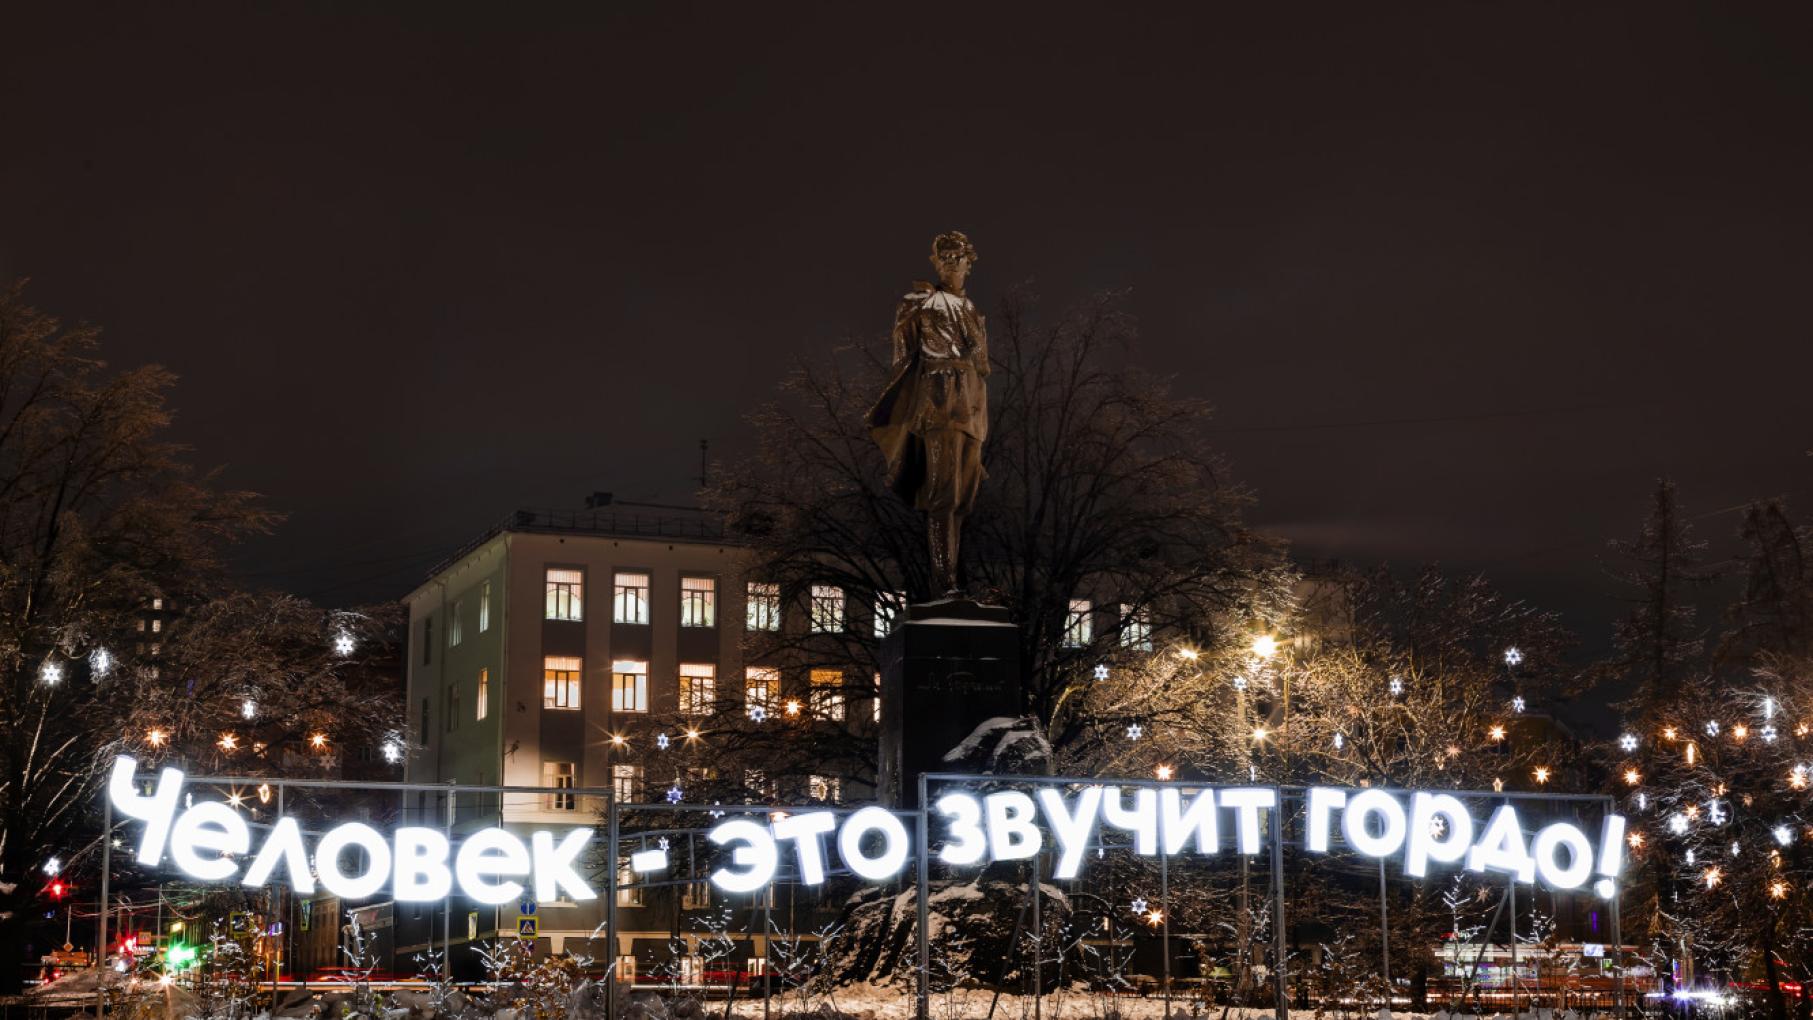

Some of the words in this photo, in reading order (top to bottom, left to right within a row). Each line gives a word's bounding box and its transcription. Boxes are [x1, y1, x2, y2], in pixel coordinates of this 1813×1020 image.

[109, 755, 598, 905] Человек
[708, 805, 909, 893] это
[937, 786, 1276, 879] звучит
[1307, 787, 1626, 900] гордо!
